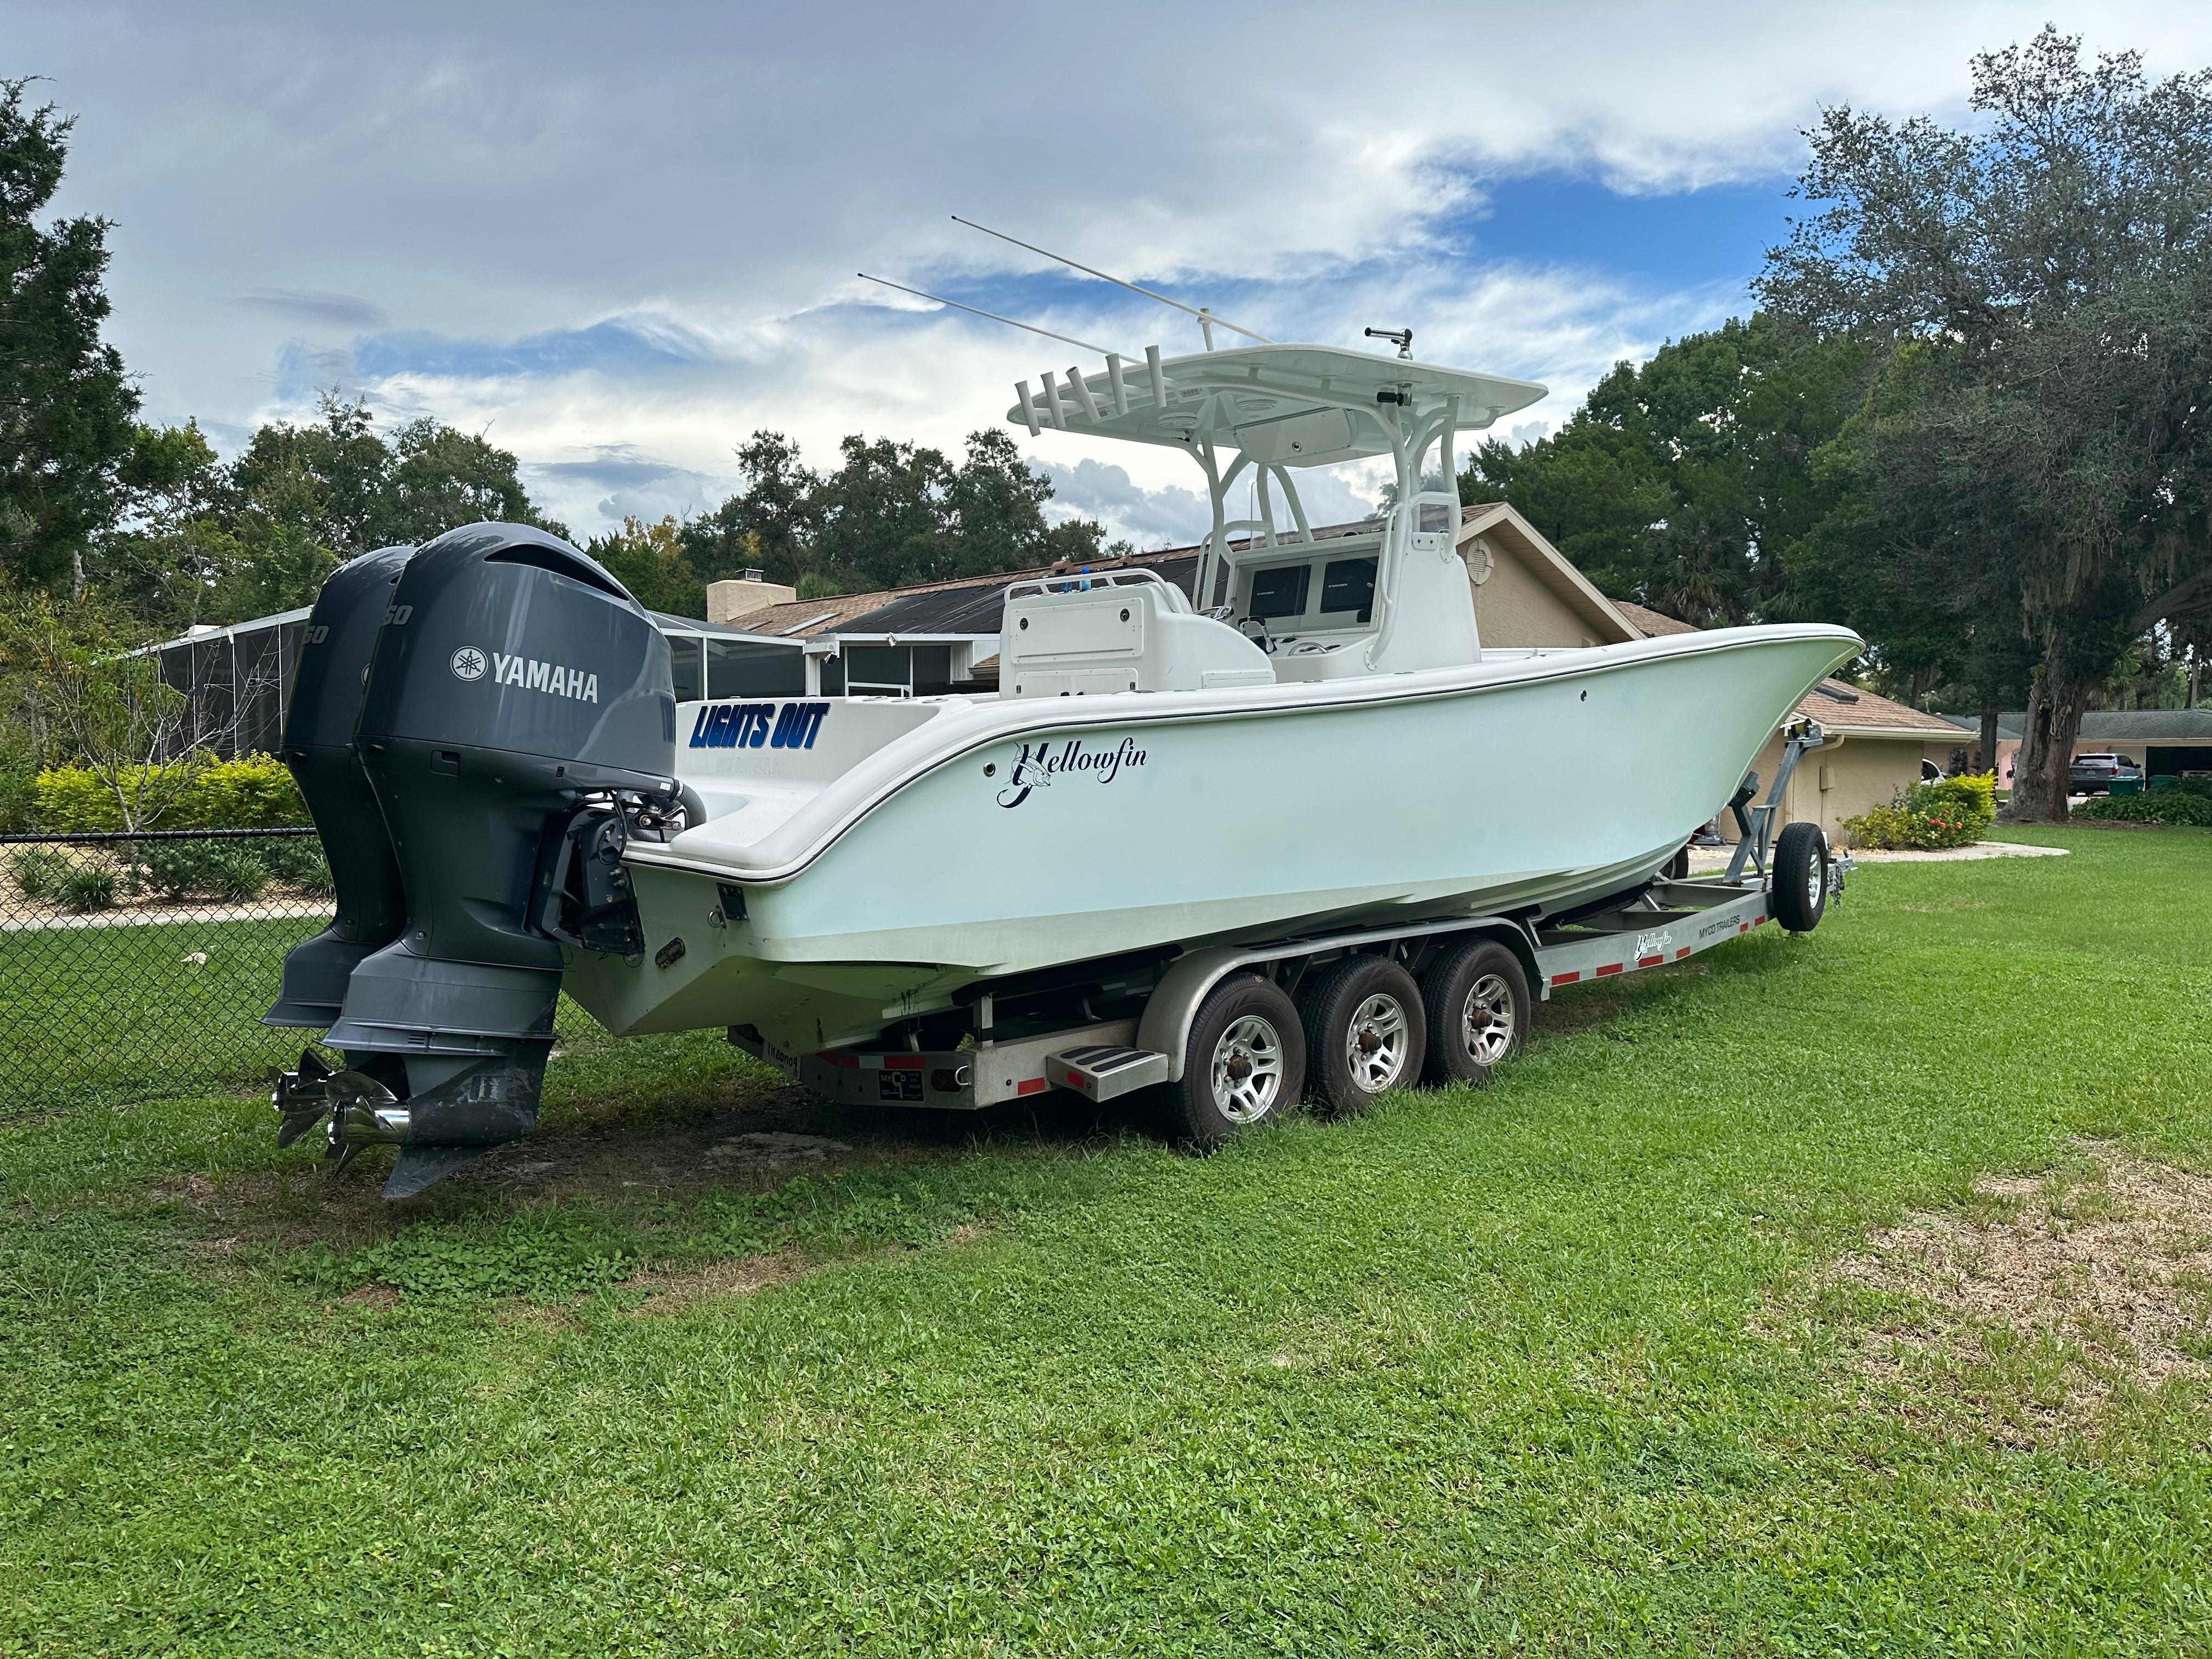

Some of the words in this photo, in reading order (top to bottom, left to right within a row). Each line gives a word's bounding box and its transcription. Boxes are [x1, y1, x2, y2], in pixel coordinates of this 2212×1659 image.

[493, 652, 598, 704] YAMAHA
[689, 703, 776, 749] LIGHTS
[770, 702, 831, 750] OUT
[997, 737, 1150, 809] Yellowfin
[1699, 923, 1716, 940] MYCO
[1716, 915, 1741, 933] TRAILERS
